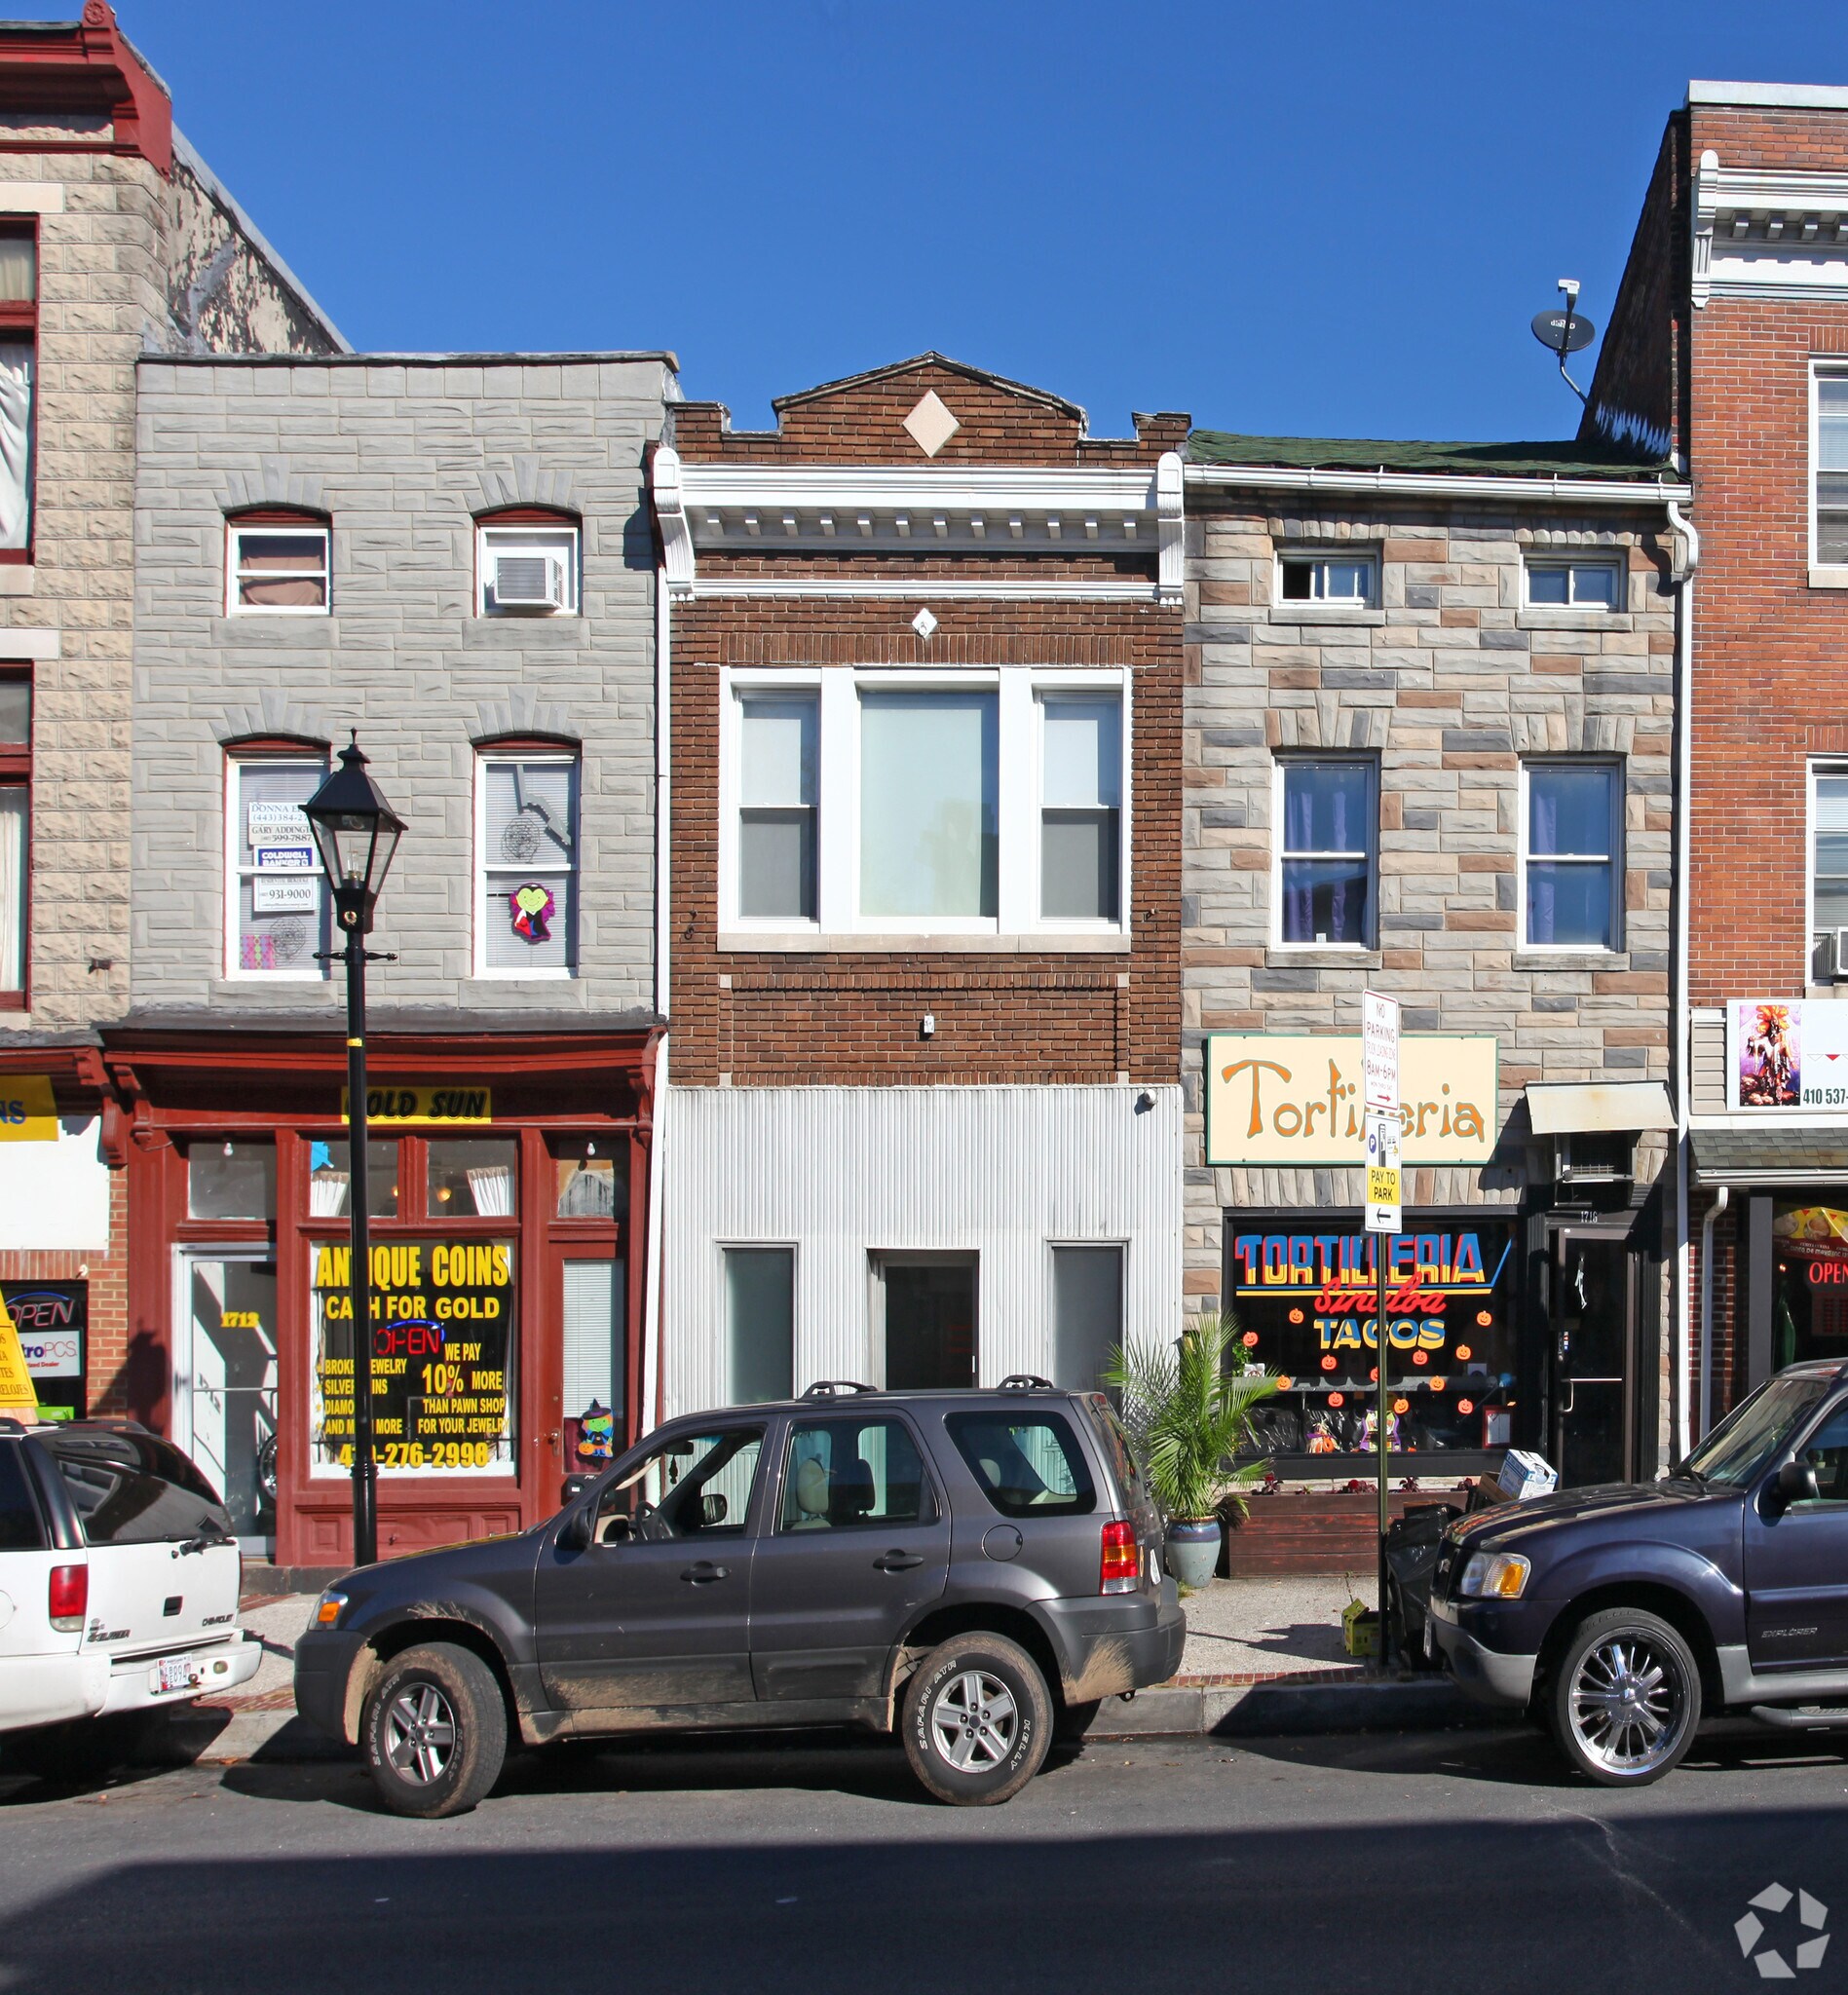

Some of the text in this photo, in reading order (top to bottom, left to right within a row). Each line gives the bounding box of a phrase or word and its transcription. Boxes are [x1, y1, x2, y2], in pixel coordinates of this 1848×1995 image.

[251, 805, 289, 813] DONNA
[252, 813, 308, 823] (443)384-27
[251, 826, 273, 835] GARY
[261, 850, 309, 860] COLDWELL
[269, 888, 312, 900] 931-9000
[1377, 1001, 1386, 1019] NO
[1366, 1021, 1395, 1044] PARKING
[1366, 1059, 1396, 1082] 8AM-6PM
[345, 1090, 486, 1120] OLD SUN
[1221, 1058, 1486, 1144] Tortieria
[1802, 1088, 1823, 1105] 410
[1371, 1170, 1396, 1186] PAY TO
[1374, 1186, 1393, 1201] PARK
[1580, 1211, 1598, 1223] 1716
[317, 1246, 509, 1291] ANQUE COINS
[326, 1296, 500, 1320] CAH FOR GOLD
[374, 1328, 440, 1355] OPEN
[1314, 1318, 1446, 1350] TACOS
[444, 1342, 482, 1362] WE PAY
[324, 1358, 408, 1375] BROKE EWELRY
[372, 1378, 389, 1395] INS
[422, 1364, 504, 1394] 10% MORE
[324, 1399, 355, 1415] DIAMO
[423, 1397, 507, 1414] THAN PAWN SHOP
[324, 1418, 345, 1435] AND
[376, 1418, 403, 1434] MORE
[418, 1417, 510, 1434] FOR YOUR JEWELRY
[339, 1442, 489, 1469] 4-276-2998
[1760, 1627, 1818, 1638] EXPLORER
[918, 1659, 958, 1750] SAFARI ATR
[1009, 1718, 1032, 1771] KELLY
